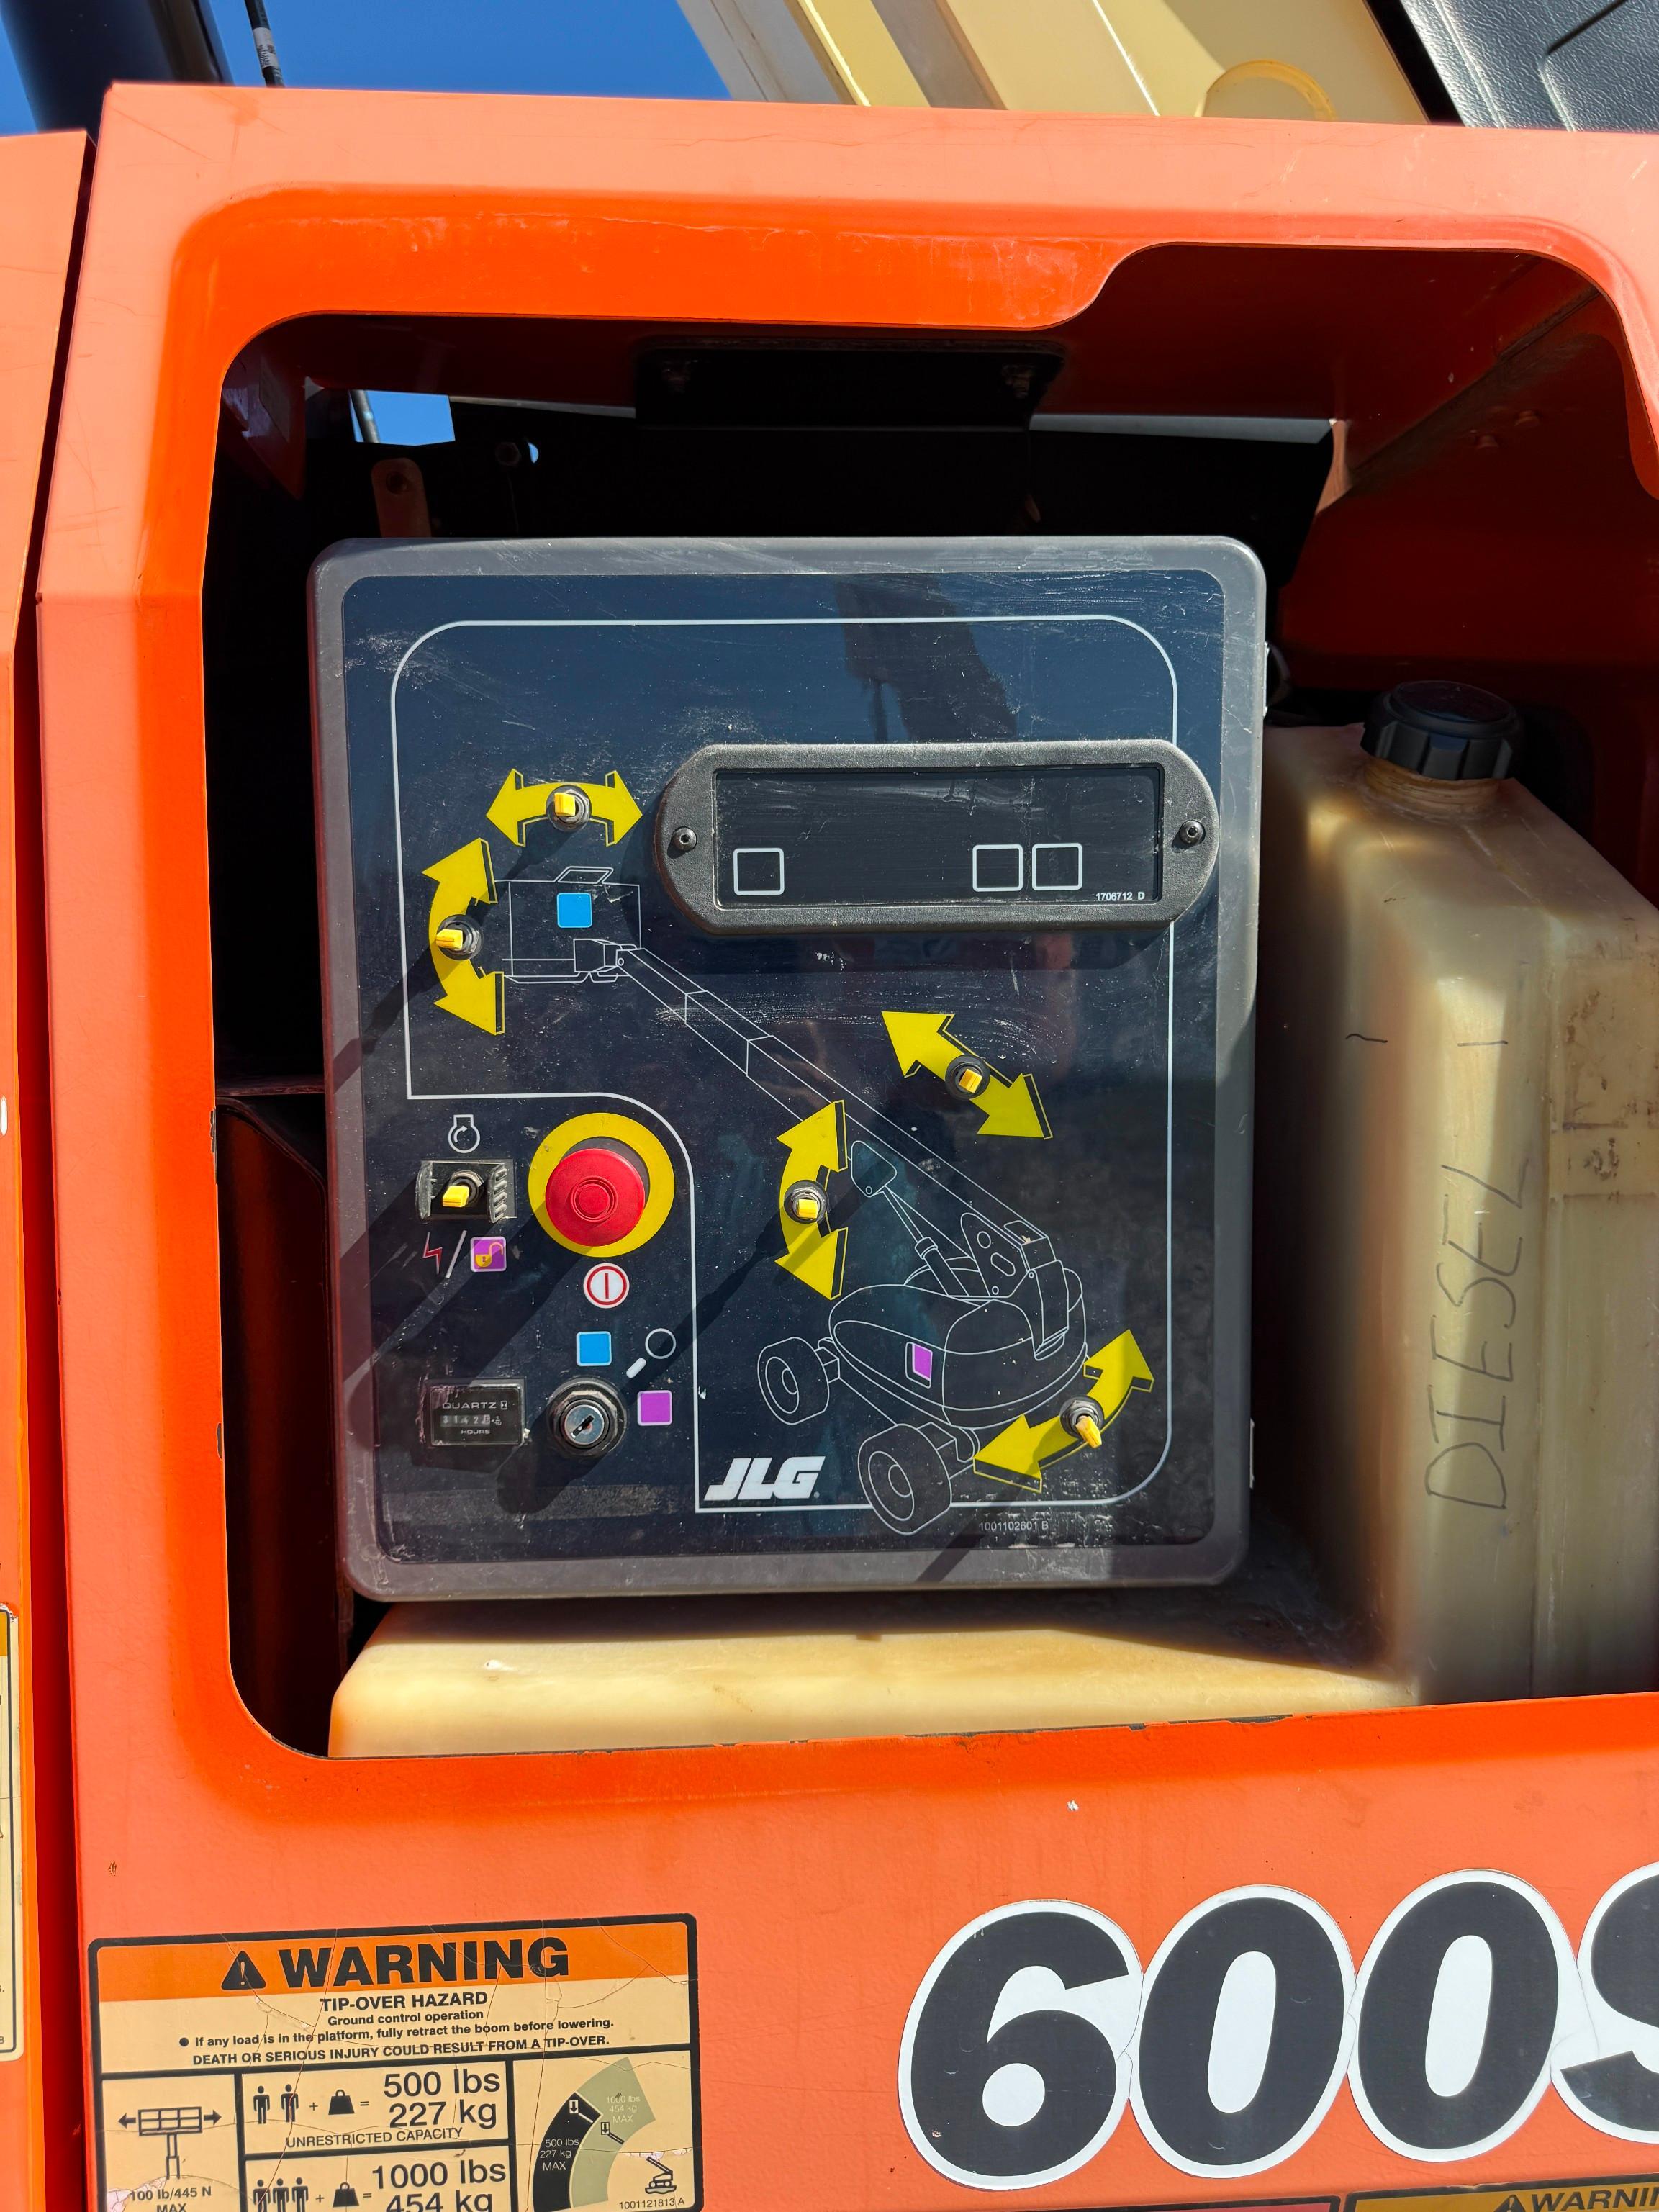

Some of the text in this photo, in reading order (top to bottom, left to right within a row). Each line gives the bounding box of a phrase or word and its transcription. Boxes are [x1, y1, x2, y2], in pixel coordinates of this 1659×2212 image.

[1095, 891, 1145, 901] 1706712 D
[1425, 1158, 1529, 1509] DIESEL
[979, 1520, 1049, 1532] 1001102601 B
[279, 1936, 569, 1988] WARNING
[320, 1991, 488, 2012] TIP-OVER HAZARD
[327, 2010, 484, 2026] Ground control operation
[195, 2018, 614, 2048] If any load is in the platform, fully retract the boom before lowering.
[193, 2035, 610, 2066] DEATH OR SERIOUS INJURY COULD RESULT FROM A TIP-OVER.
[384, 2068, 500, 2098] 500 lbs
[628, 2095, 641, 2103] lbs
[389, 2099, 497, 2129] 227 kg
[627, 2104, 637, 2113] kg
[612, 2115, 633, 2123] MAX
[286, 2127, 463, 2148] UNRESTRICTED CAPACITY
[545, 2138, 579, 2147] 500 lbs
[540, 2149, 571, 2159] 227 kg
[372, 2159, 507, 2189] 1000 lbs
[543, 2162, 566, 2171] MAX
[130, 2186, 212, 2201] 100 lb/445 N
[386, 2190, 493, 2212] 454 kg
[156, 2203, 187, 2212] MAX
[619, 2197, 685, 2210] 1001121813 A
